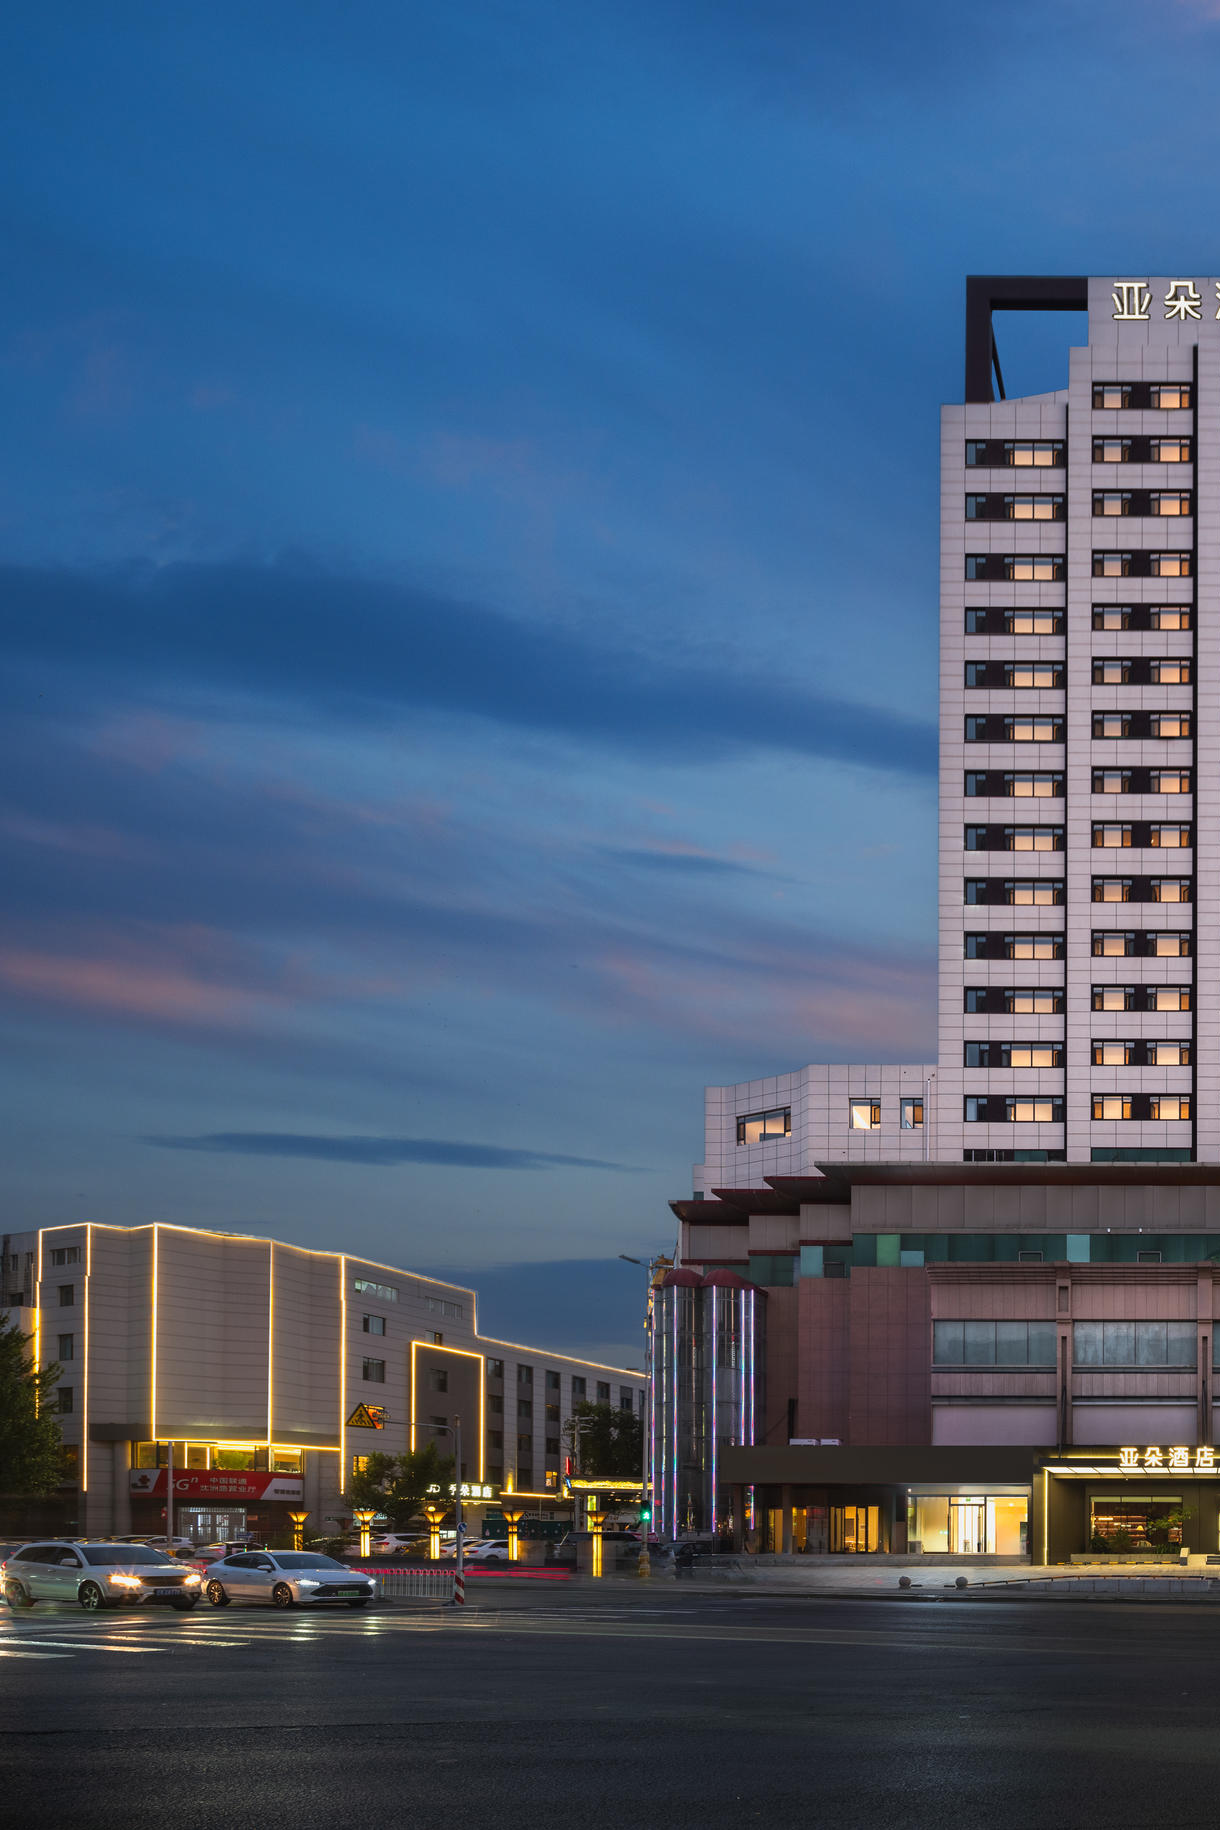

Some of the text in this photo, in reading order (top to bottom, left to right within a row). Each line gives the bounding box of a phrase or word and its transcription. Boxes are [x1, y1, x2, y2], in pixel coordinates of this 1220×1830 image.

[1118, 1446, 1216, 1468] 亚朵酒店
[209, 1477, 248, 1485] 中国联通
